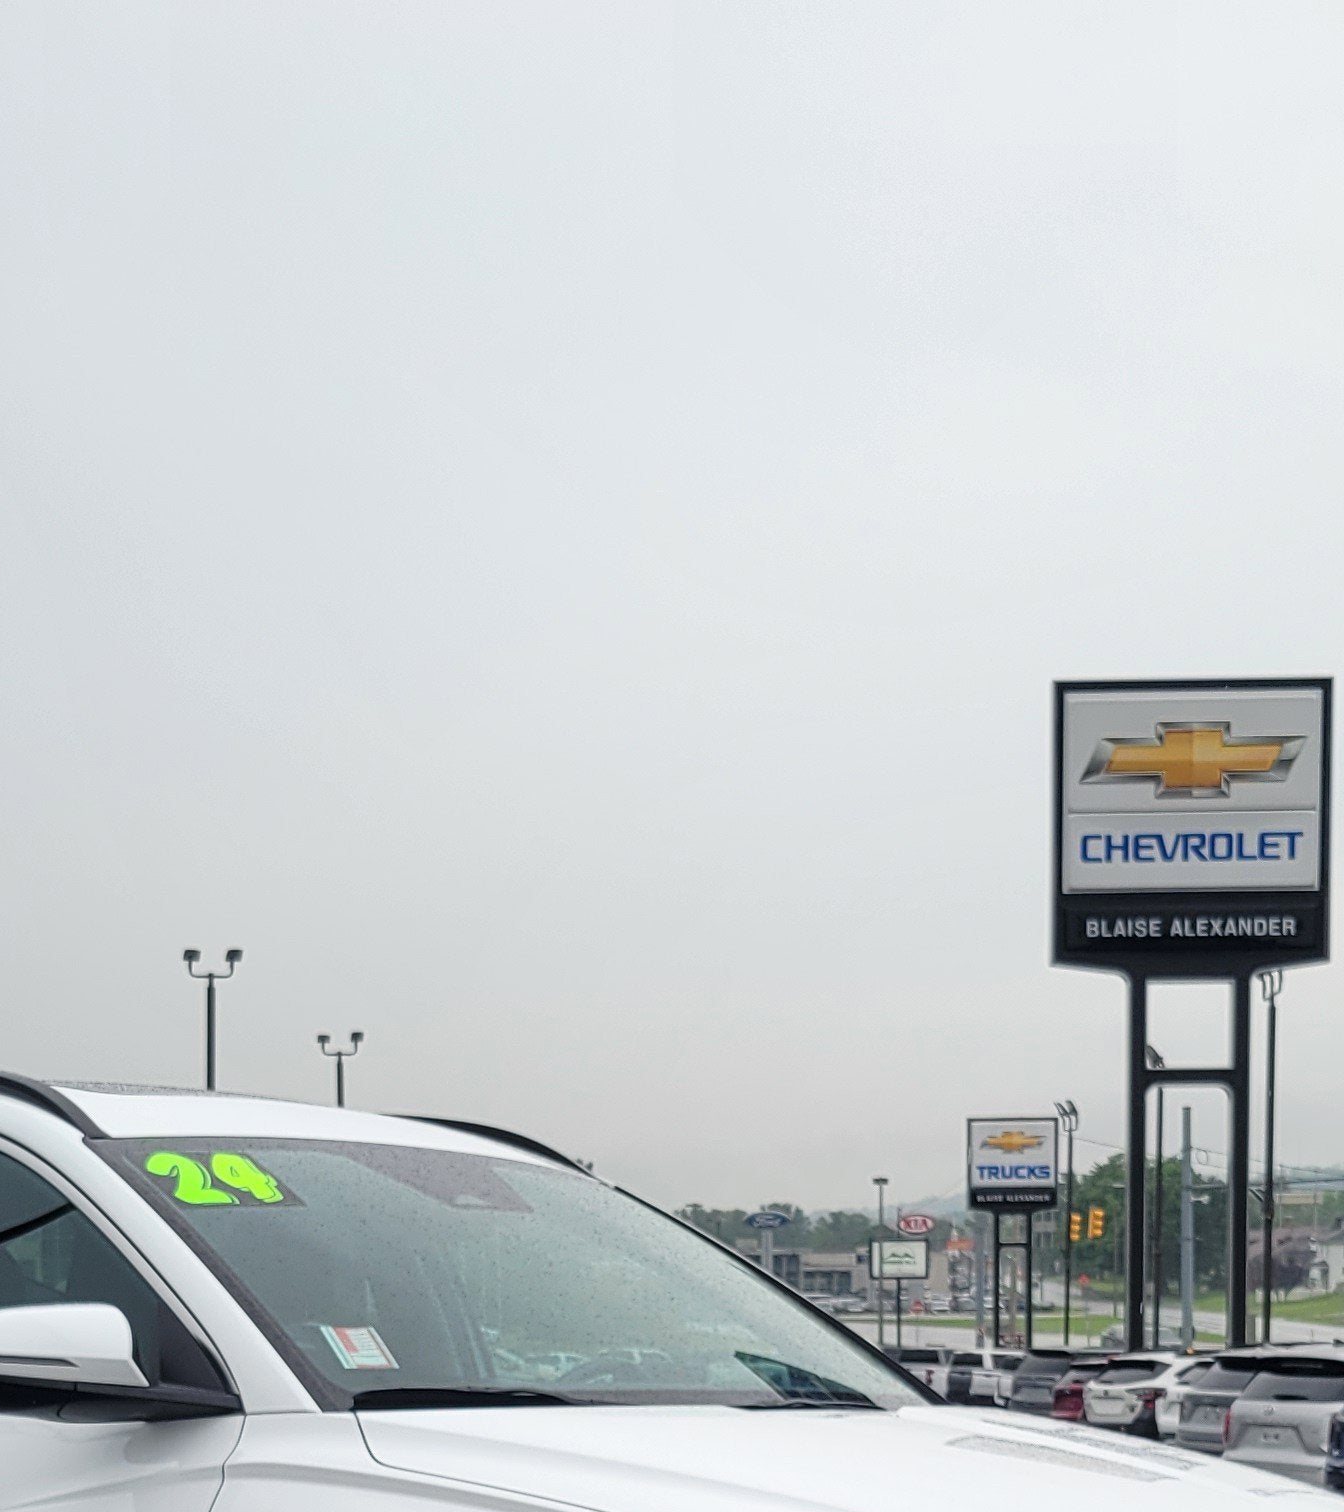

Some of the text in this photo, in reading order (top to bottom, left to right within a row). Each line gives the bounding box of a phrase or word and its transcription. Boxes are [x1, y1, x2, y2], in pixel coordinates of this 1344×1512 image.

[1079, 831, 1304, 864] CHEVROLET
[1085, 916, 1298, 939] BLAISE ALEXANDER
[146, 1152, 284, 1206] 24
[976, 1165, 1051, 1180] TRUCKS
